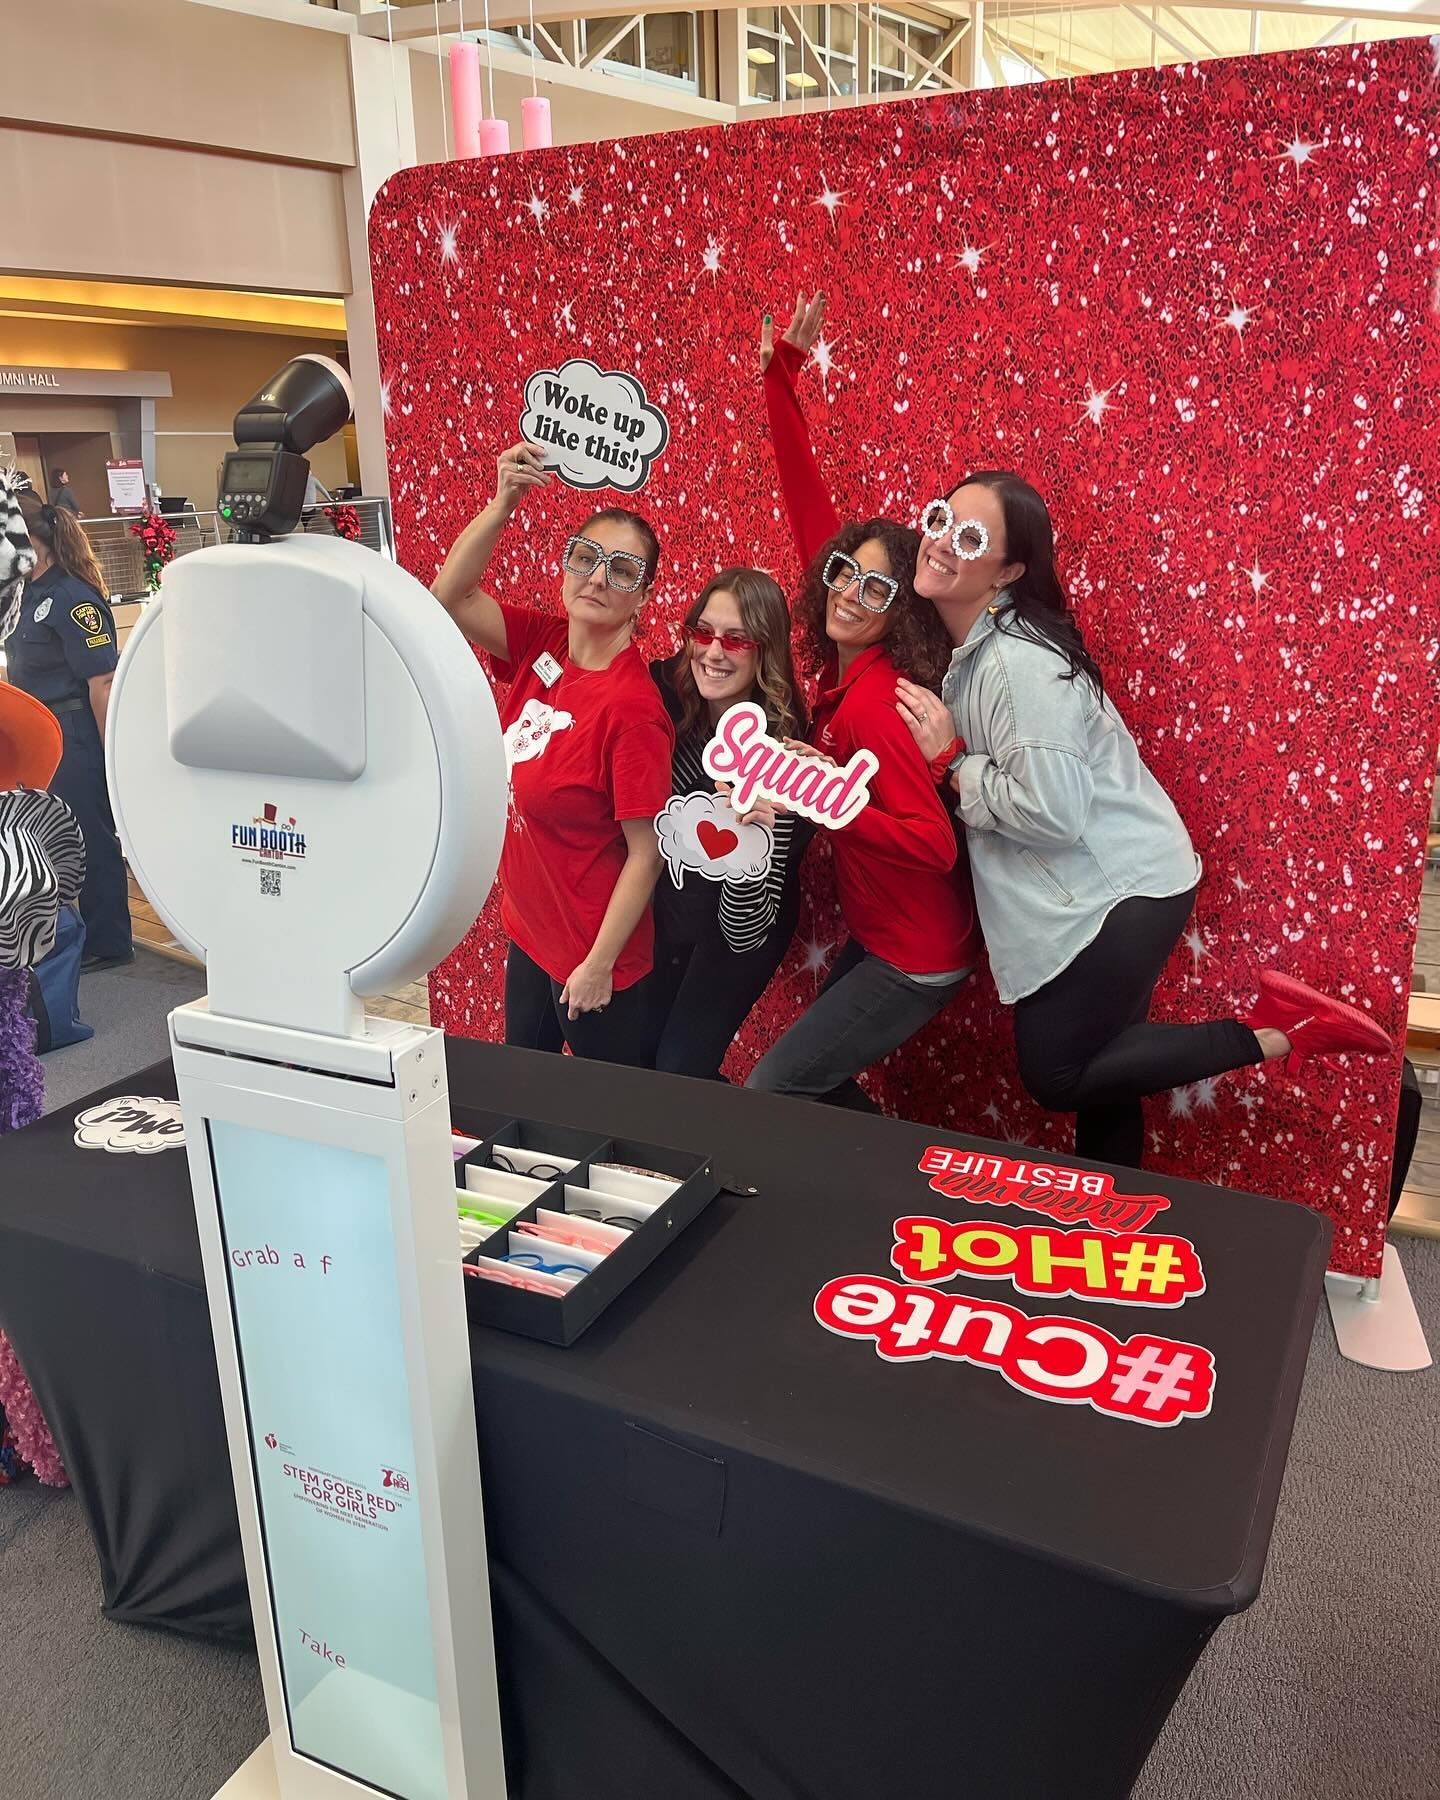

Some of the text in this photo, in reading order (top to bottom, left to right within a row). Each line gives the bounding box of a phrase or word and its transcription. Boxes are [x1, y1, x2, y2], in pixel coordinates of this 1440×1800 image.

[28, 373, 60, 387] HALL
[543, 380, 646, 442] Woke up
[533, 414, 640, 472] like this!
[709, 710, 870, 820] Squad
[232, 824, 306, 854] FUN BOOTH
[927, 1150, 1104, 1196] BEST LIFE
[231, 1244, 332, 1274] Grab a f
[908, 1225, 1186, 1294] #Hot
[831, 1283, 1195, 1411] #Cute
[283, 1464, 319, 1486] STEM
[323, 1479, 363, 1501] GOES
[303, 1484, 377, 1519] FOR GIRLS
[298, 1628, 346, 1669] Take
